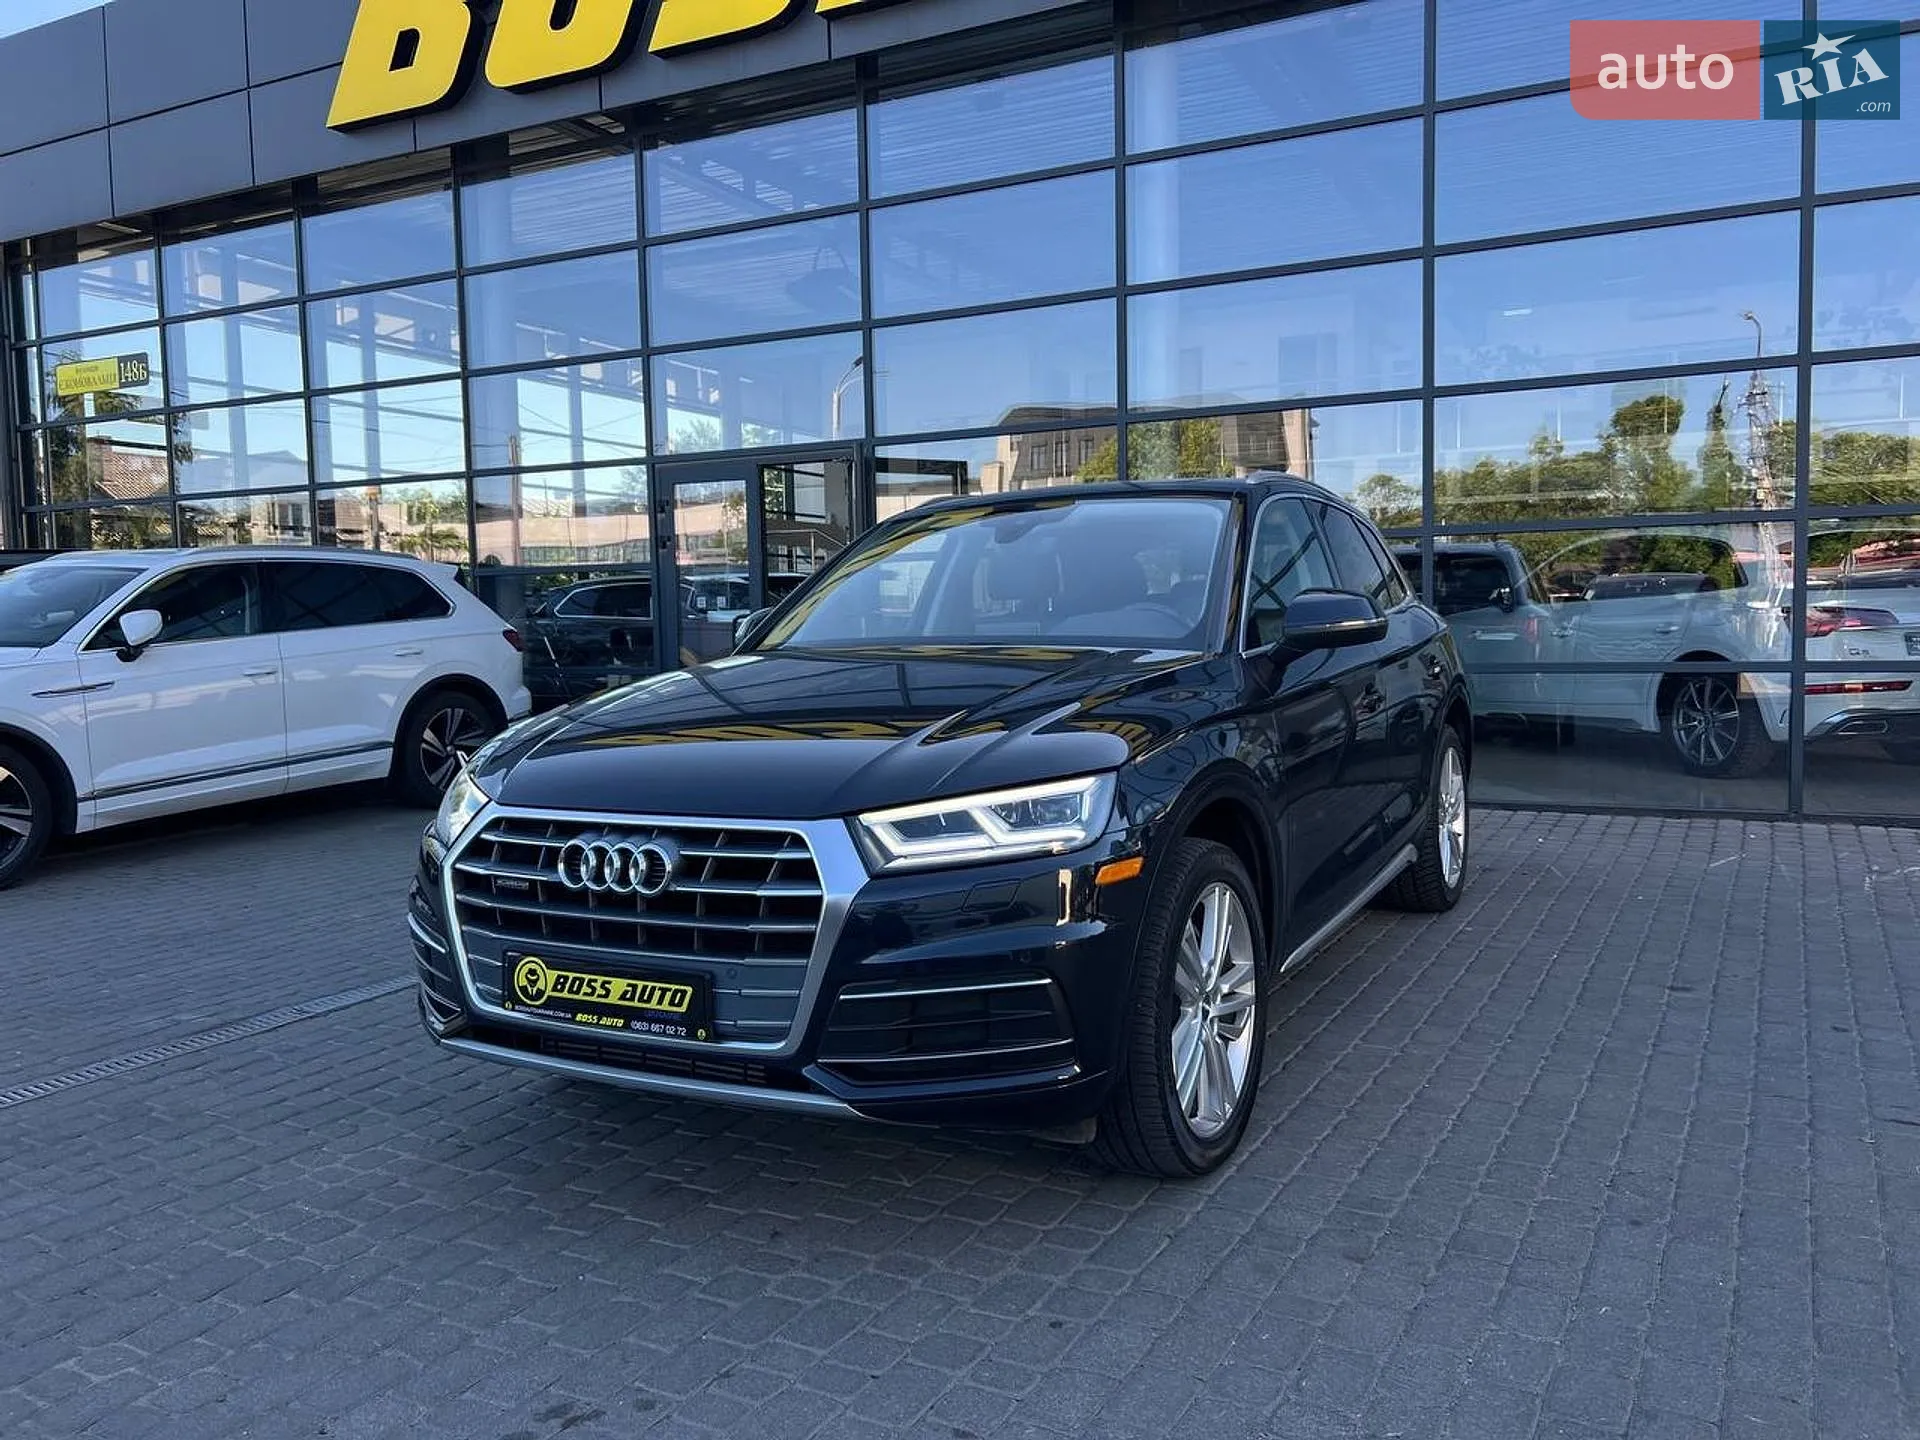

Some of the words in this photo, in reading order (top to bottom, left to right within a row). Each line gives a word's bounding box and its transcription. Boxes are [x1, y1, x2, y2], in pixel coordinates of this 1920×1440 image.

[551, 974, 613, 999] BOSS
[619, 983, 688, 1008] AUTO
[575, 1012, 598, 1024] BOSS
[599, 1016, 624, 1027] AUTO
